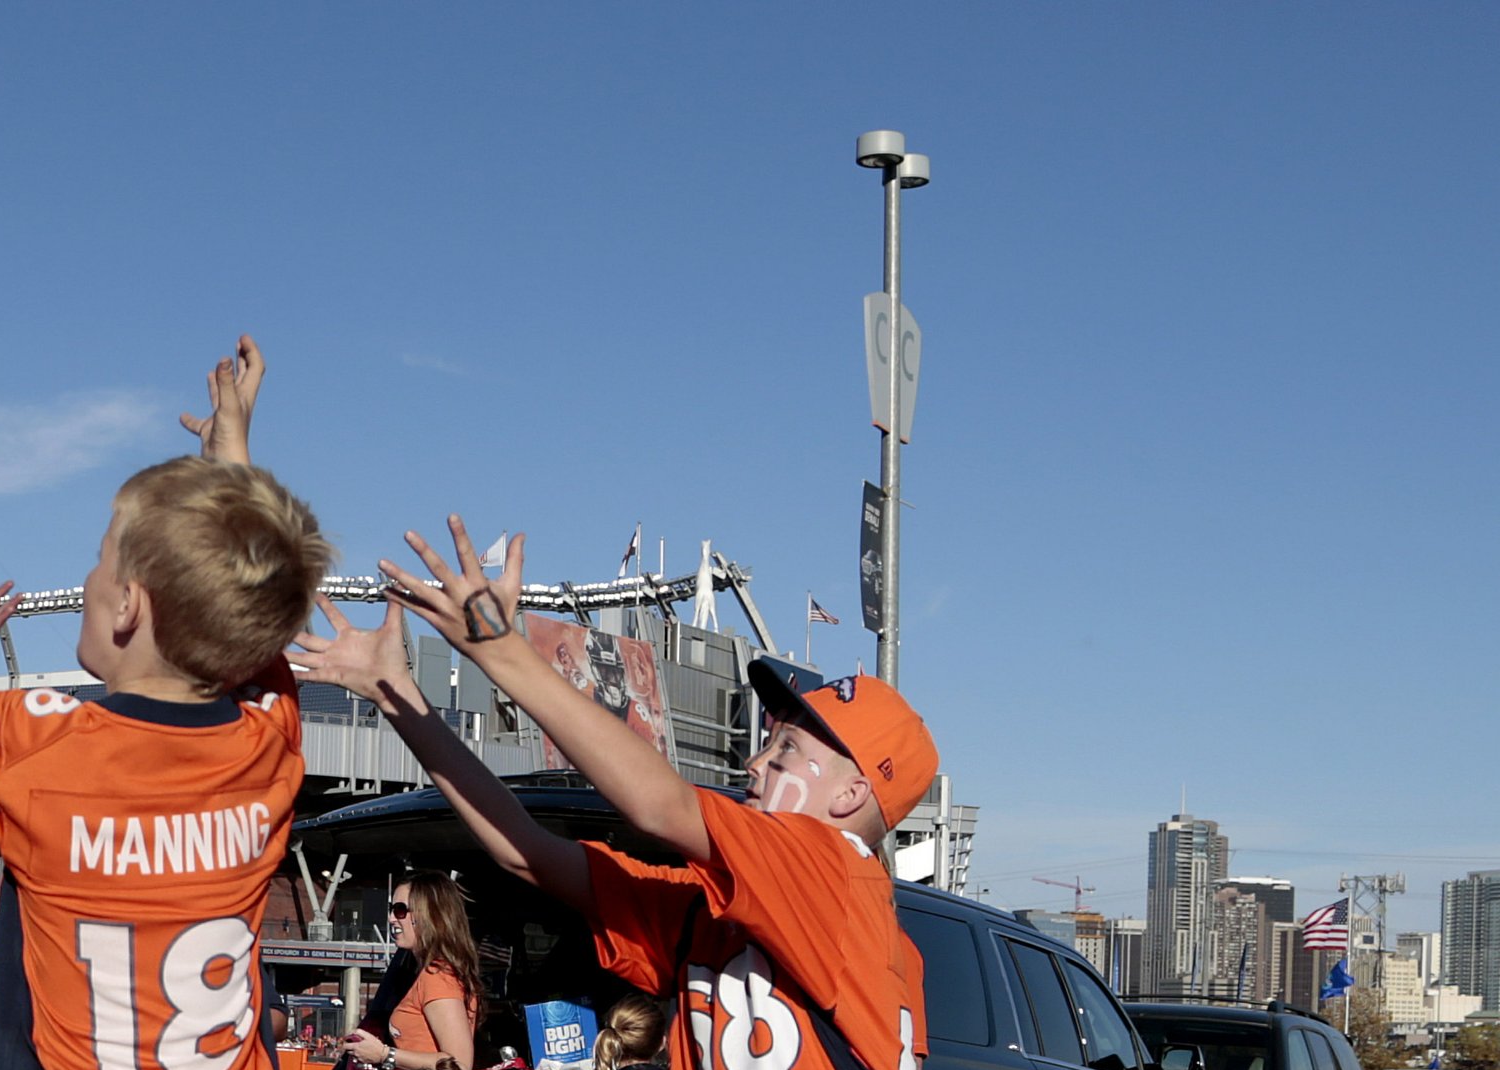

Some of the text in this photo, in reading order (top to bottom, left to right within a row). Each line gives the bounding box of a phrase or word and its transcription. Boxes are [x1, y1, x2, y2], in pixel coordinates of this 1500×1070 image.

[876, 312, 887, 364] C
[902, 330, 914, 381] C
[69, 802, 271, 875] MANNING
[544, 1035, 586, 1055] LIGHT
[545, 1023, 581, 1042] BUD
